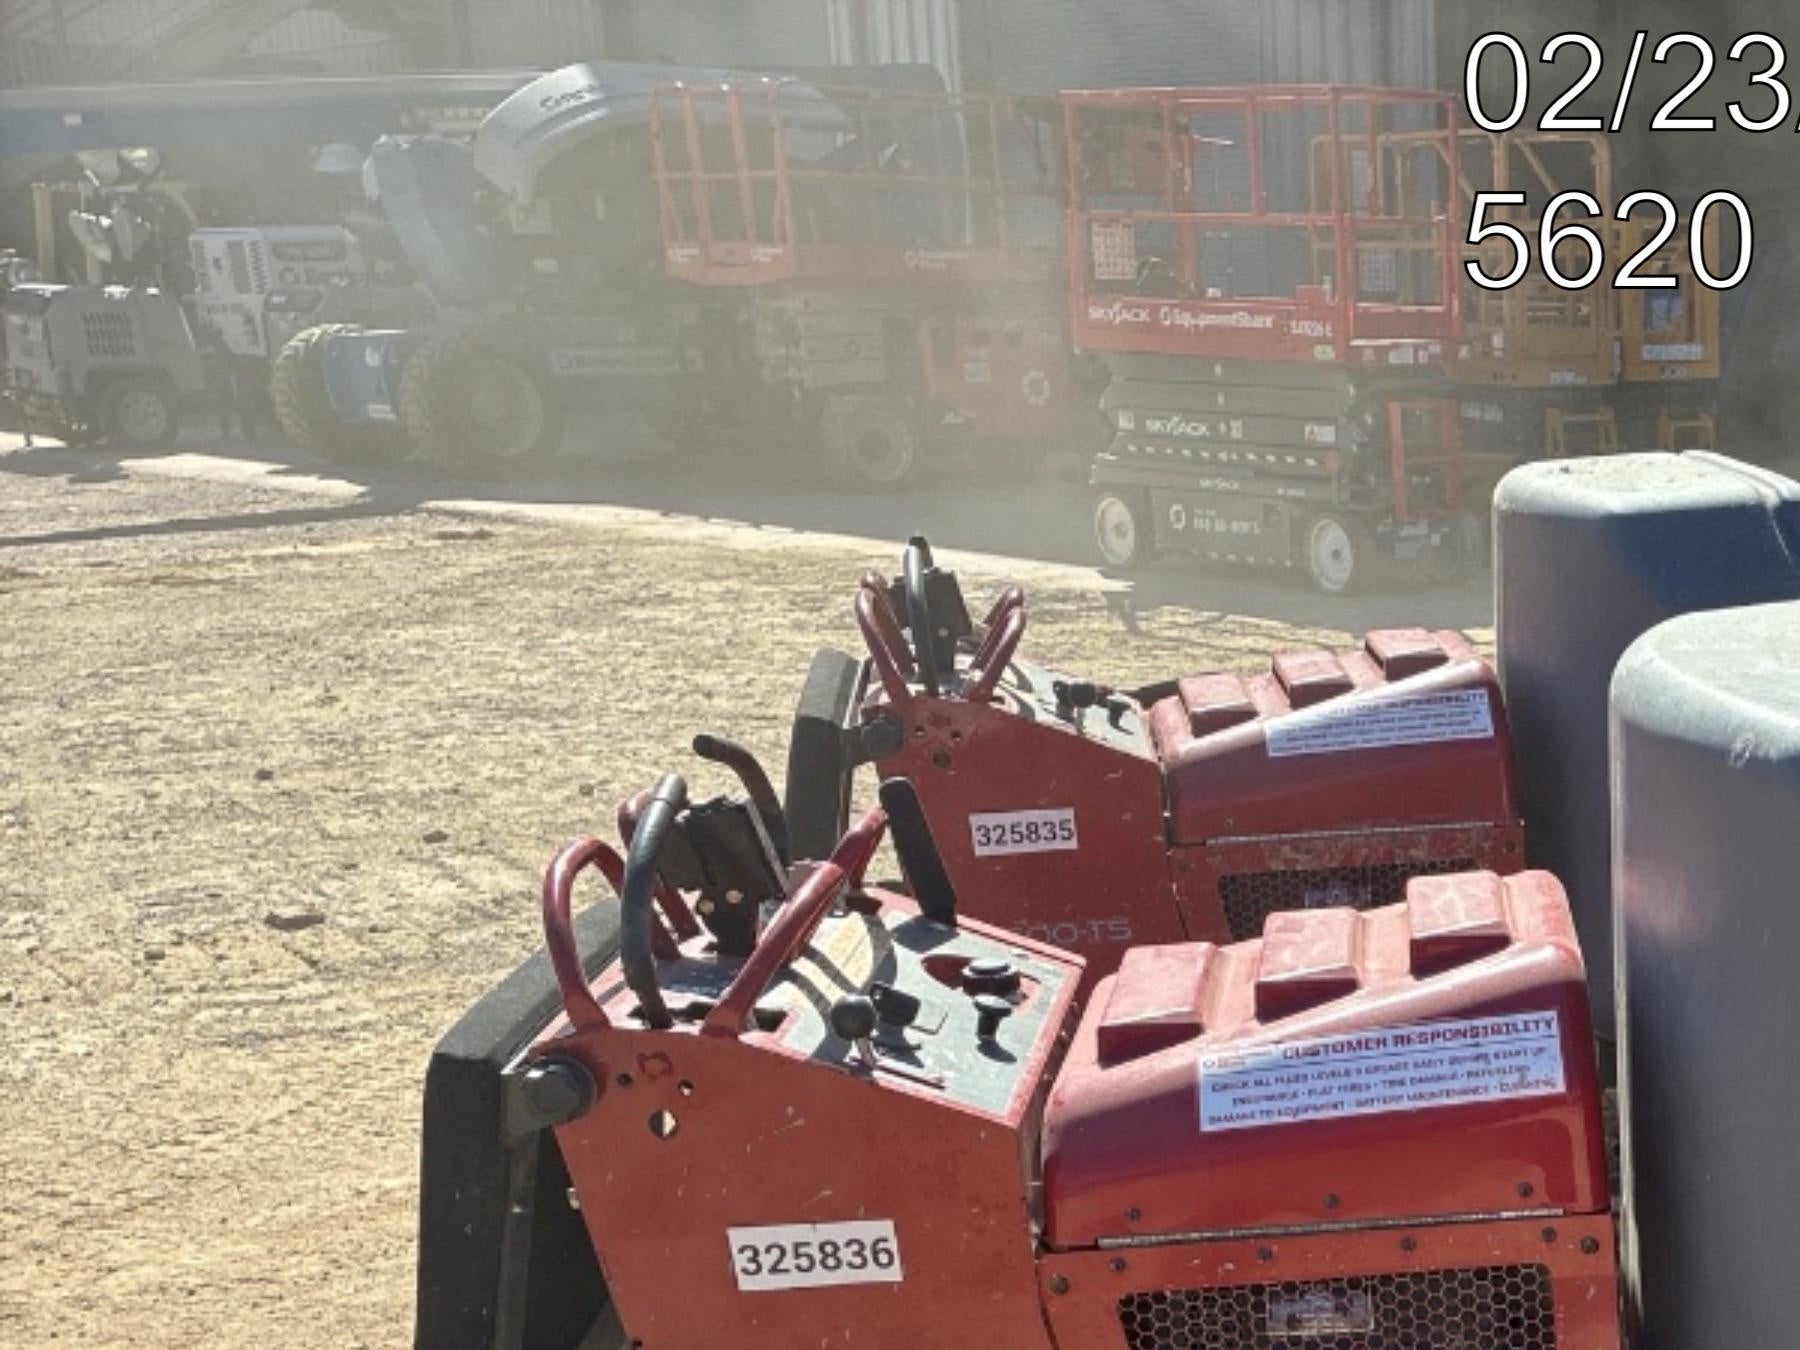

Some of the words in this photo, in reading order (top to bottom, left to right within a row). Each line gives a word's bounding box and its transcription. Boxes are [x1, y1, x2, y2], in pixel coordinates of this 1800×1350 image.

[975, 818, 1074, 847] 325835
[1283, 1036, 1387, 1060] CUSTOMER
[1391, 1016, 1555, 1048] RESPONSIBILITY
[1277, 1100, 1345, 1119] EQUIPMENT
[736, 1236, 894, 1276] 325836
